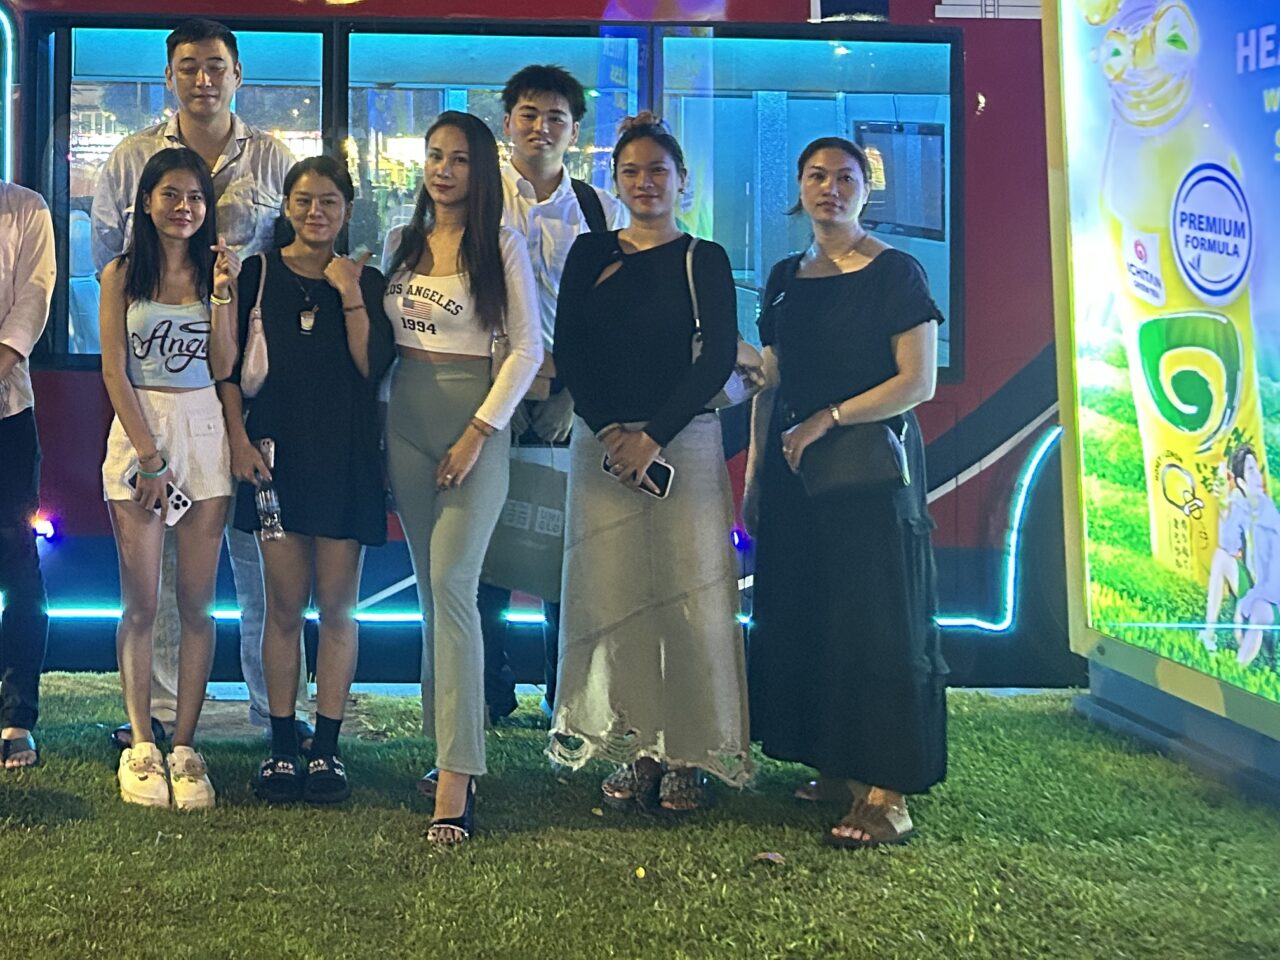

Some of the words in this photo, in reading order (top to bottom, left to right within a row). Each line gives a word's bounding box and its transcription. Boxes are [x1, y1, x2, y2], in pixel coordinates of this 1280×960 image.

[1180, 211, 1246, 240] PREMIUM
[1185, 234, 1240, 258] FORMULA
[385, 283, 403, 297] LOS
[406, 284, 464, 316] ANGELES
[401, 317, 437, 335] 1994
[131, 319, 210, 374] Ang
